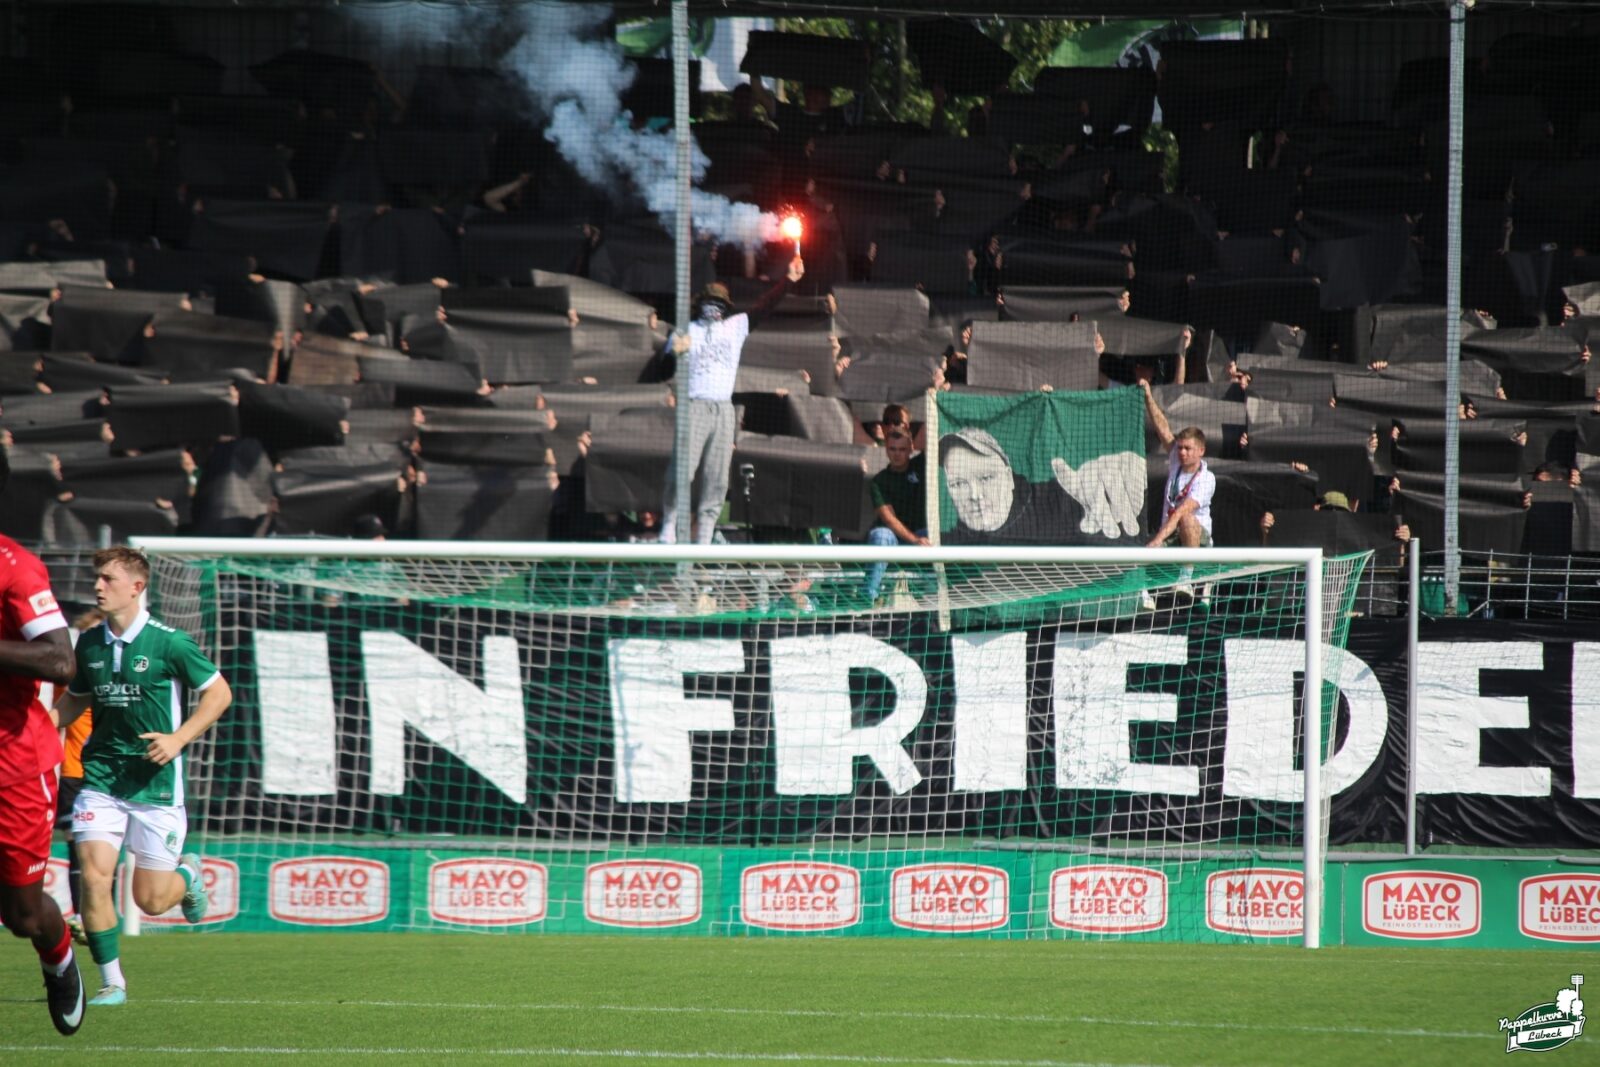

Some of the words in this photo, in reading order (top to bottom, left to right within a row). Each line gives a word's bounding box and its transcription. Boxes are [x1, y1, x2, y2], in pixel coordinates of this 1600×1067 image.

[252, 631, 527, 804] IN
[289, 868, 369, 889] MAYO
[449, 869, 528, 890] MAYO
[604, 871, 682, 891] MAYO
[761, 873, 841, 894] MAYO
[910, 874, 990, 896] MAYO
[1069, 875, 1149, 897] MAYO
[289, 890, 368, 907] LÜBECK
[1226, 879, 1304, 901] MAYO
[1382, 882, 1462, 904] MAYO
[604, 893, 680, 909] LÜBECK
[761, 895, 839, 912] LÜBECK
[910, 896, 988, 913] LÜBECK
[1069, 898, 1147, 915] LÜBECK
[1226, 901, 1303, 918] LÜBECK
[1383, 904, 1461, 921] LÜBECK
